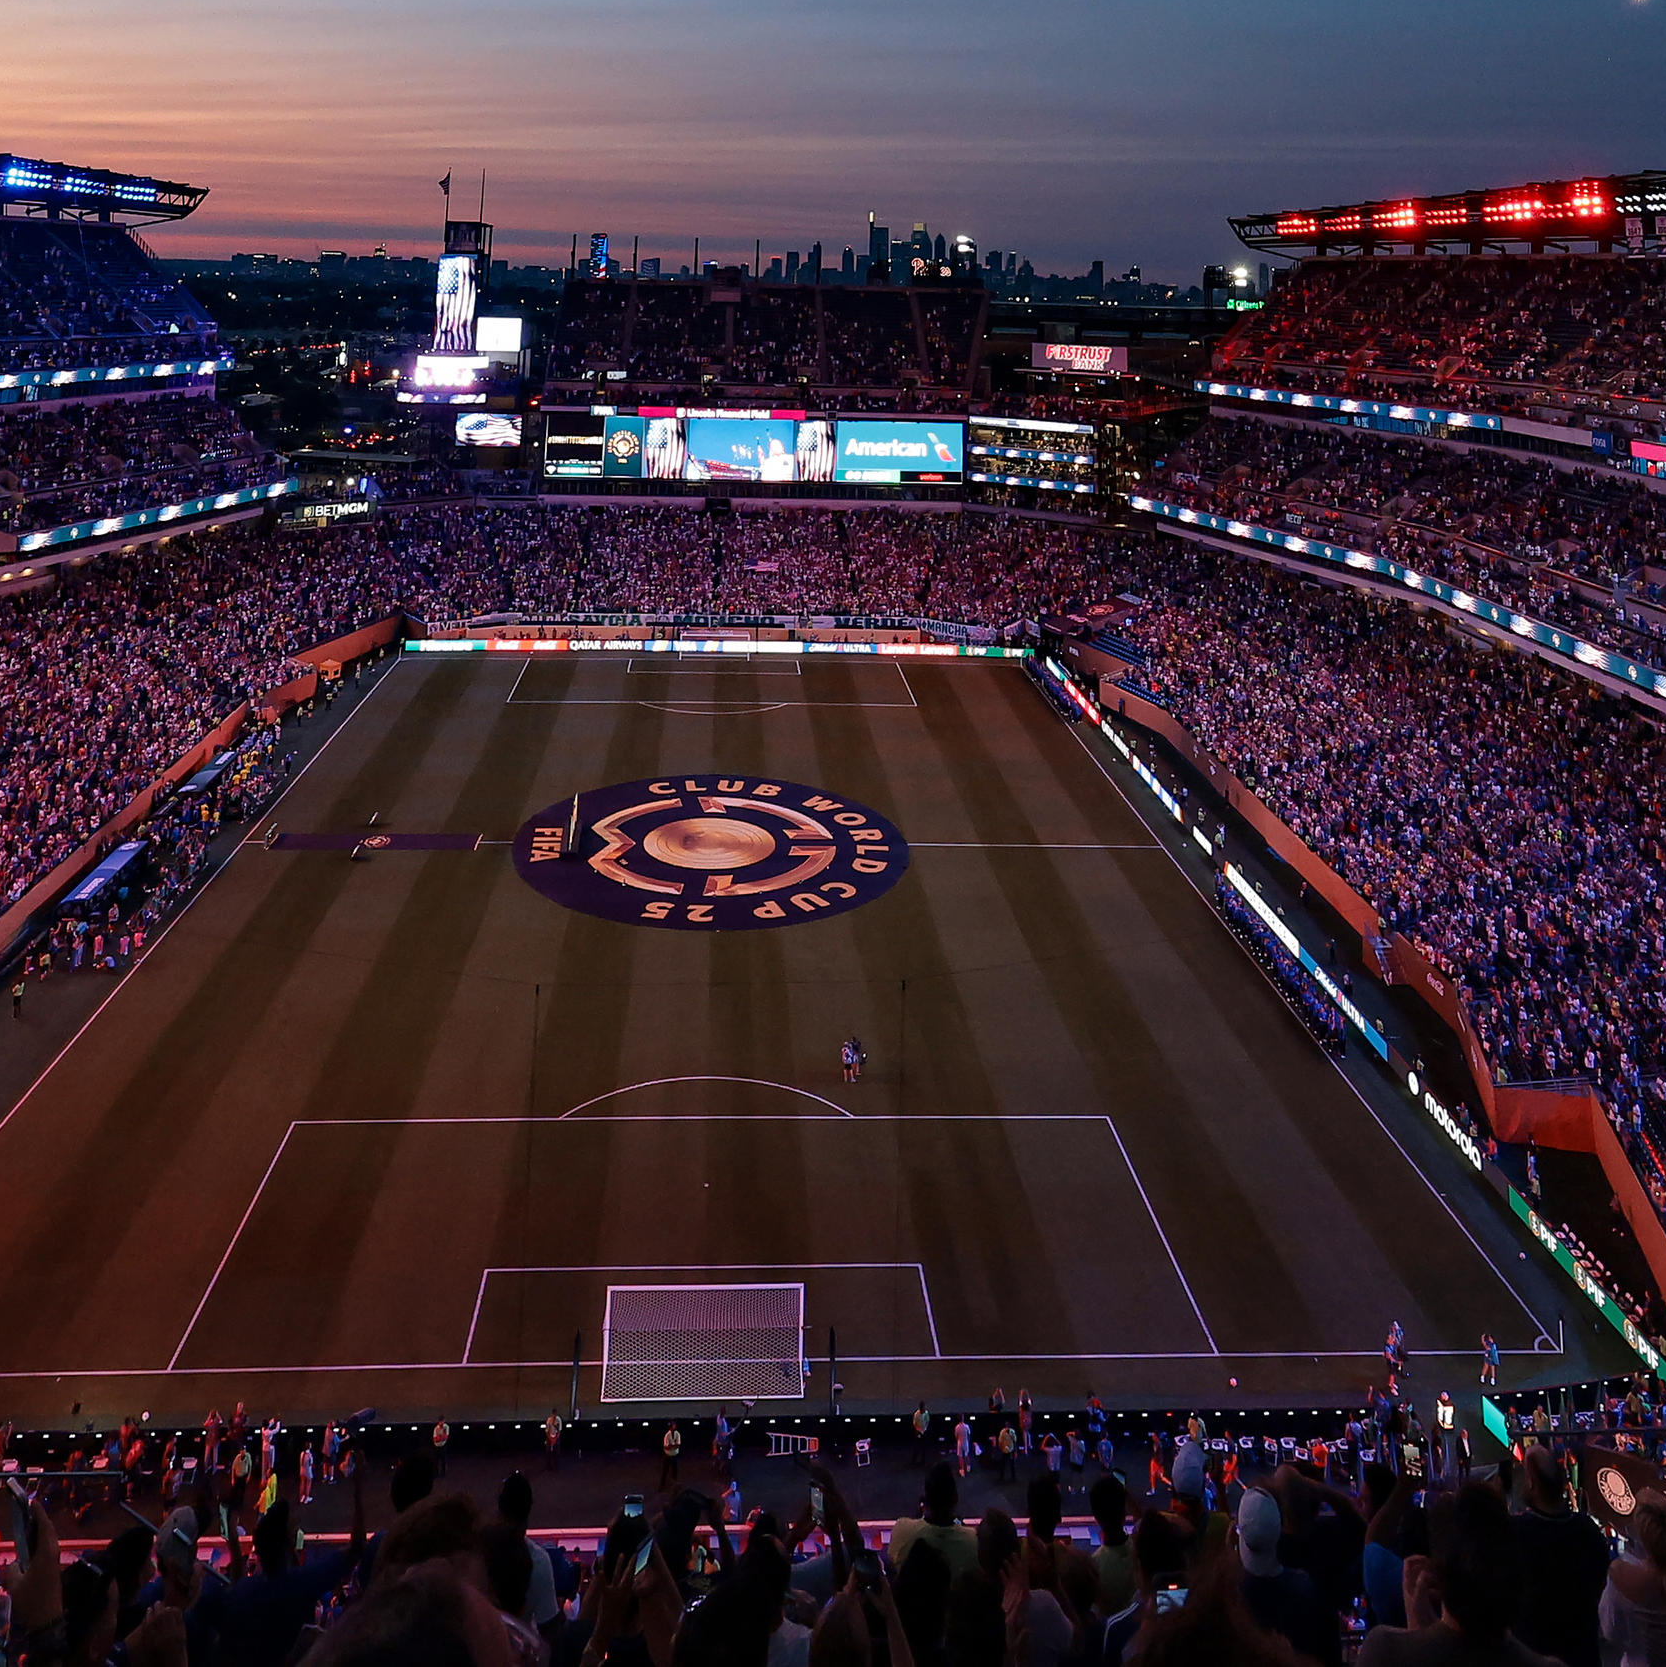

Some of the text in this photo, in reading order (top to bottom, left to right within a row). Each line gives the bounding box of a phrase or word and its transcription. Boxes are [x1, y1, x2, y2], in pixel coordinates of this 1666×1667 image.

[1045, 344, 1112, 362] FIRSTRUST
[1072, 359, 1104, 370] BANK
[687, 408, 715, 418] Lincoln
[845, 438, 927, 457] American
[315, 502, 369, 516] BETMGM
[569, 640, 643, 651] QATAR AIRWAYS
[530, 827, 564, 863] FIFA
[641, 779, 889, 922] CLUB WORLD CUP 25
[1341, 996, 1366, 1033] ULTRA
[1424, 1091, 1482, 1171] motorola
[1540, 1223, 1558, 1253] PIF
[1586, 1275, 1606, 1308] PIF
[1637, 1337, 1659, 1369] PIF
